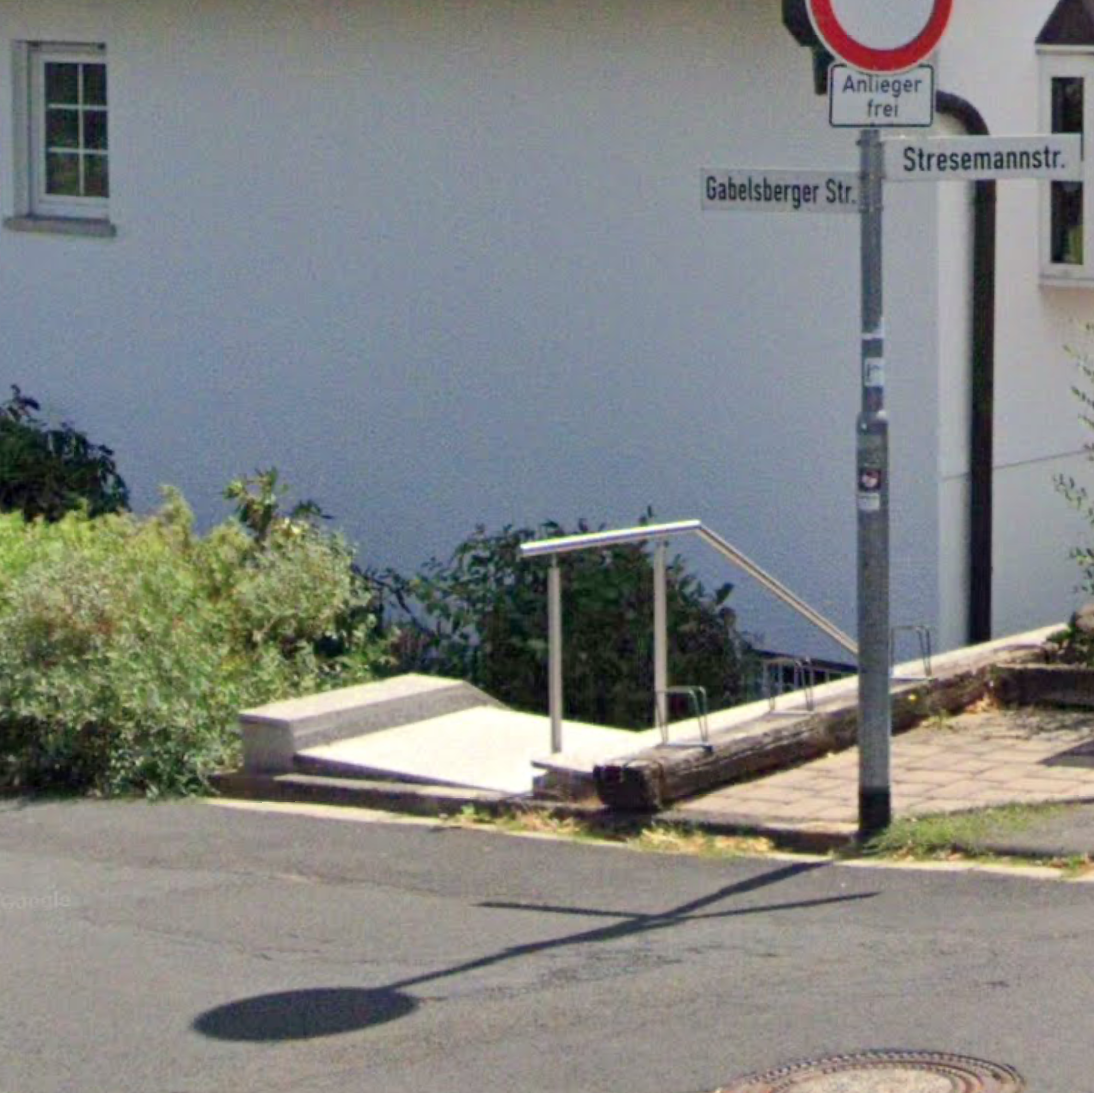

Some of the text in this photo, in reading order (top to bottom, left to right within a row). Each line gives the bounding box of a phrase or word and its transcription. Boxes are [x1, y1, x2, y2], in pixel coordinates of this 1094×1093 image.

[842, 75, 922, 97] Anlieger
[866, 99, 899, 118] frei
[903, 146, 1066, 172] Stresemannstr.
[705, 175, 857, 209] Gabelsberger Str.
